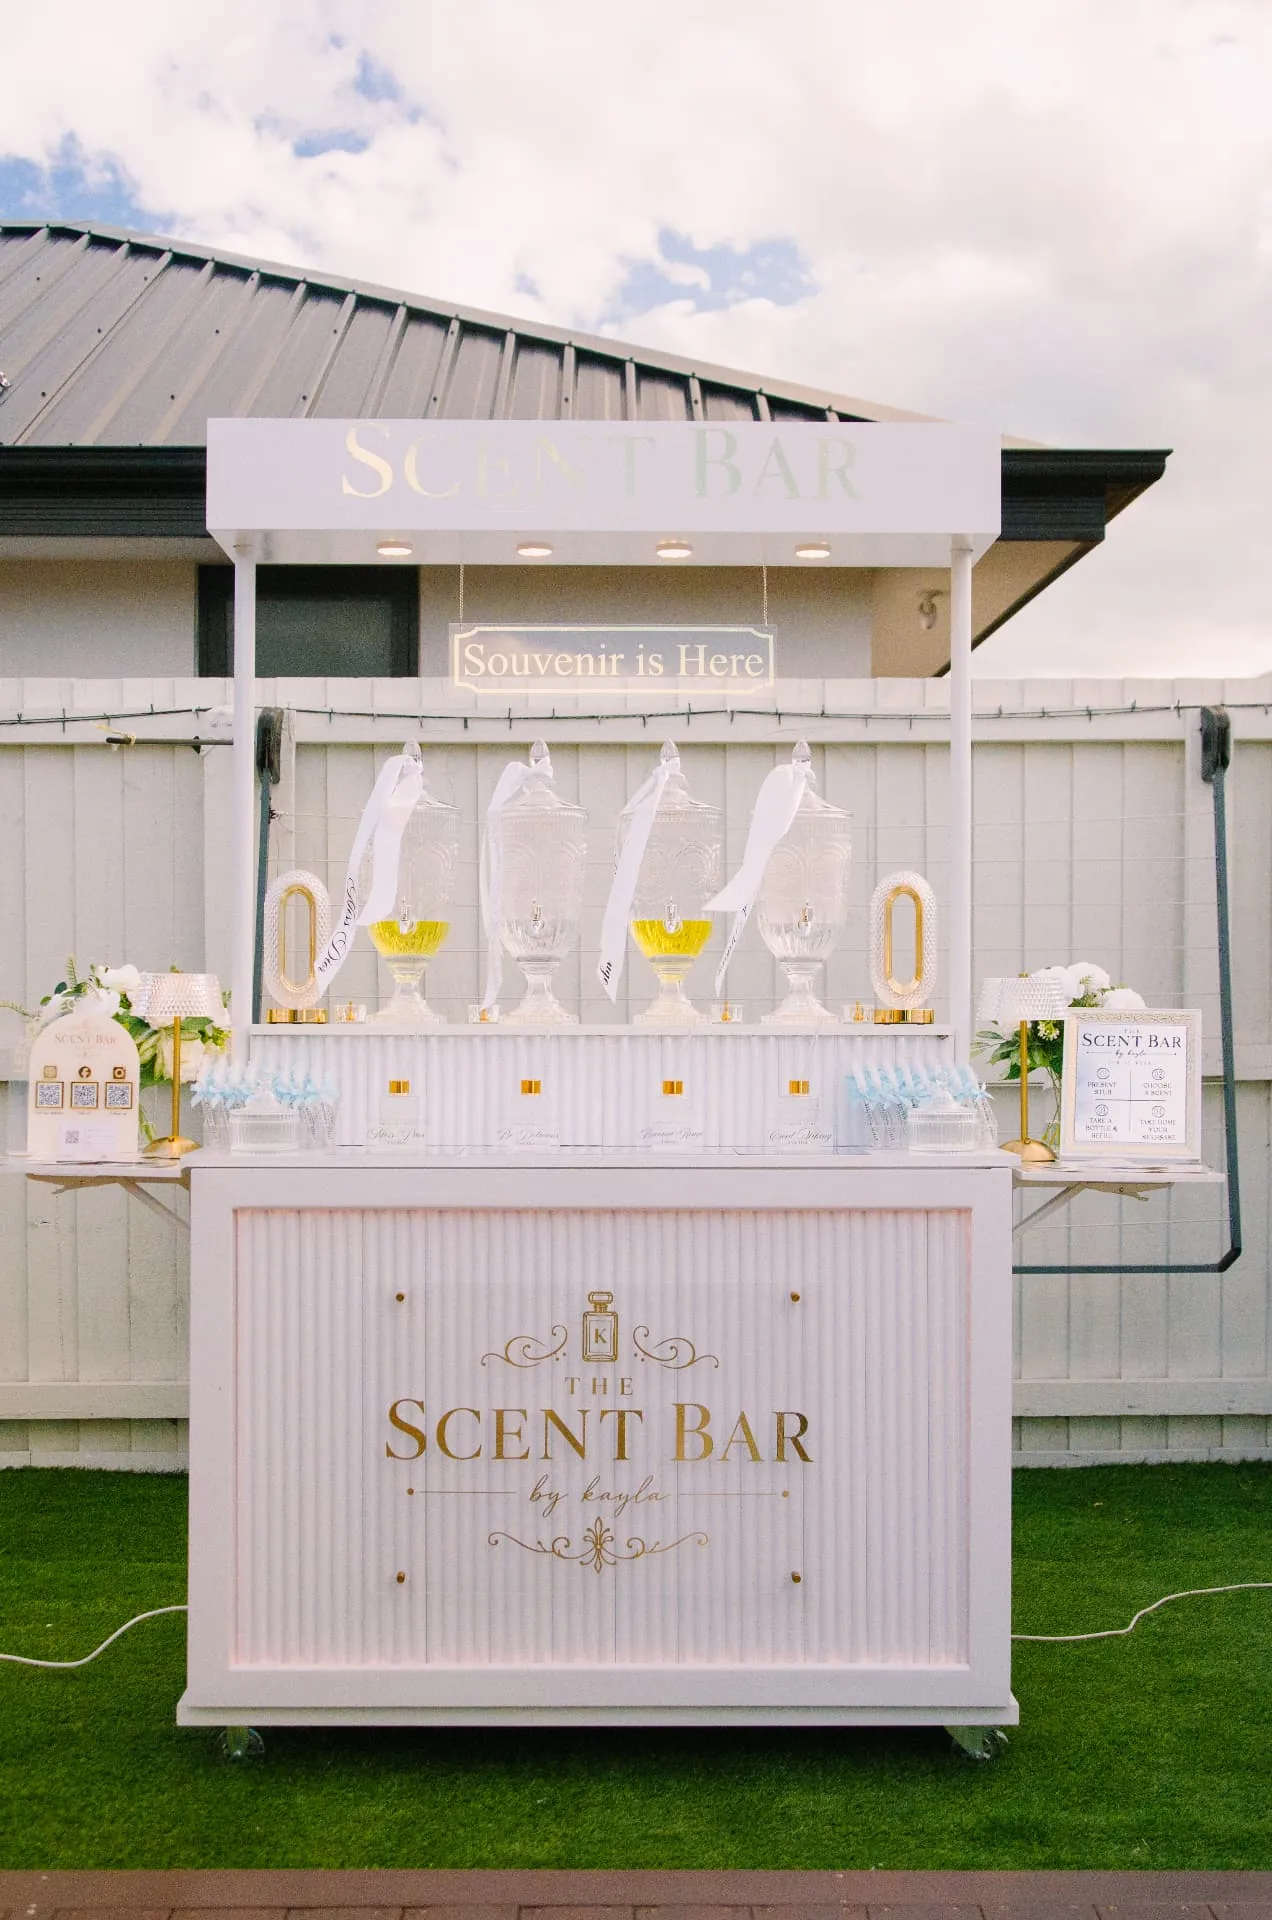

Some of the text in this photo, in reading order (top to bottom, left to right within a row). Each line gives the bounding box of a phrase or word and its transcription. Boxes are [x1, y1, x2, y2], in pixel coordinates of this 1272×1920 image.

[692, 427, 862, 501] BAR
[463, 642, 764, 678] Souvenir is Here
[1082, 1032, 1182, 1049] SCENT BAR
[594, 1327, 608, 1345] K
[564, 1376, 634, 1396] THE
[385, 1398, 815, 1464] SCENT BAR
[529, 1472, 671, 1518] by kayla
